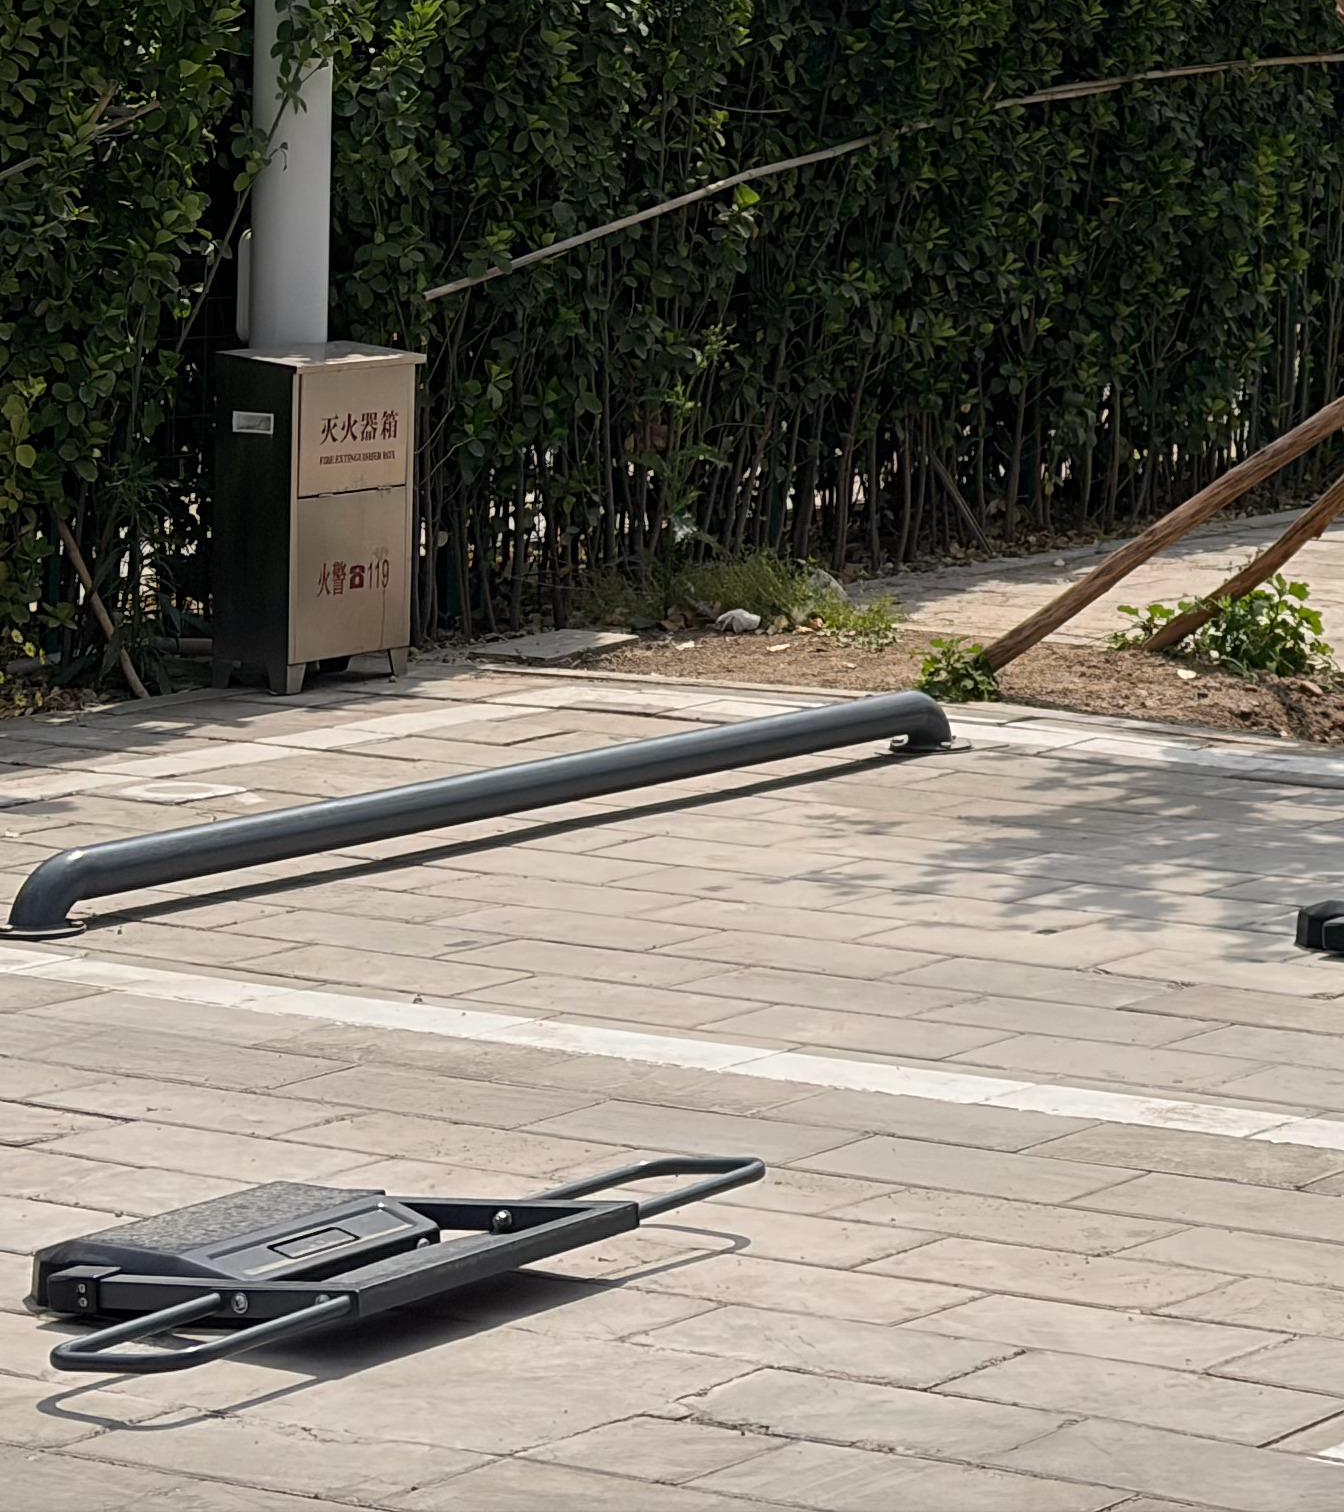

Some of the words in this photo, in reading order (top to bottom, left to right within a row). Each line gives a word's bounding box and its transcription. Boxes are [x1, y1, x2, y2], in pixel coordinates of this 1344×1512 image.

[319, 409, 399, 446] 灭火器箱
[316, 561, 347, 598] 火警
[367, 558, 391, 590] 119
